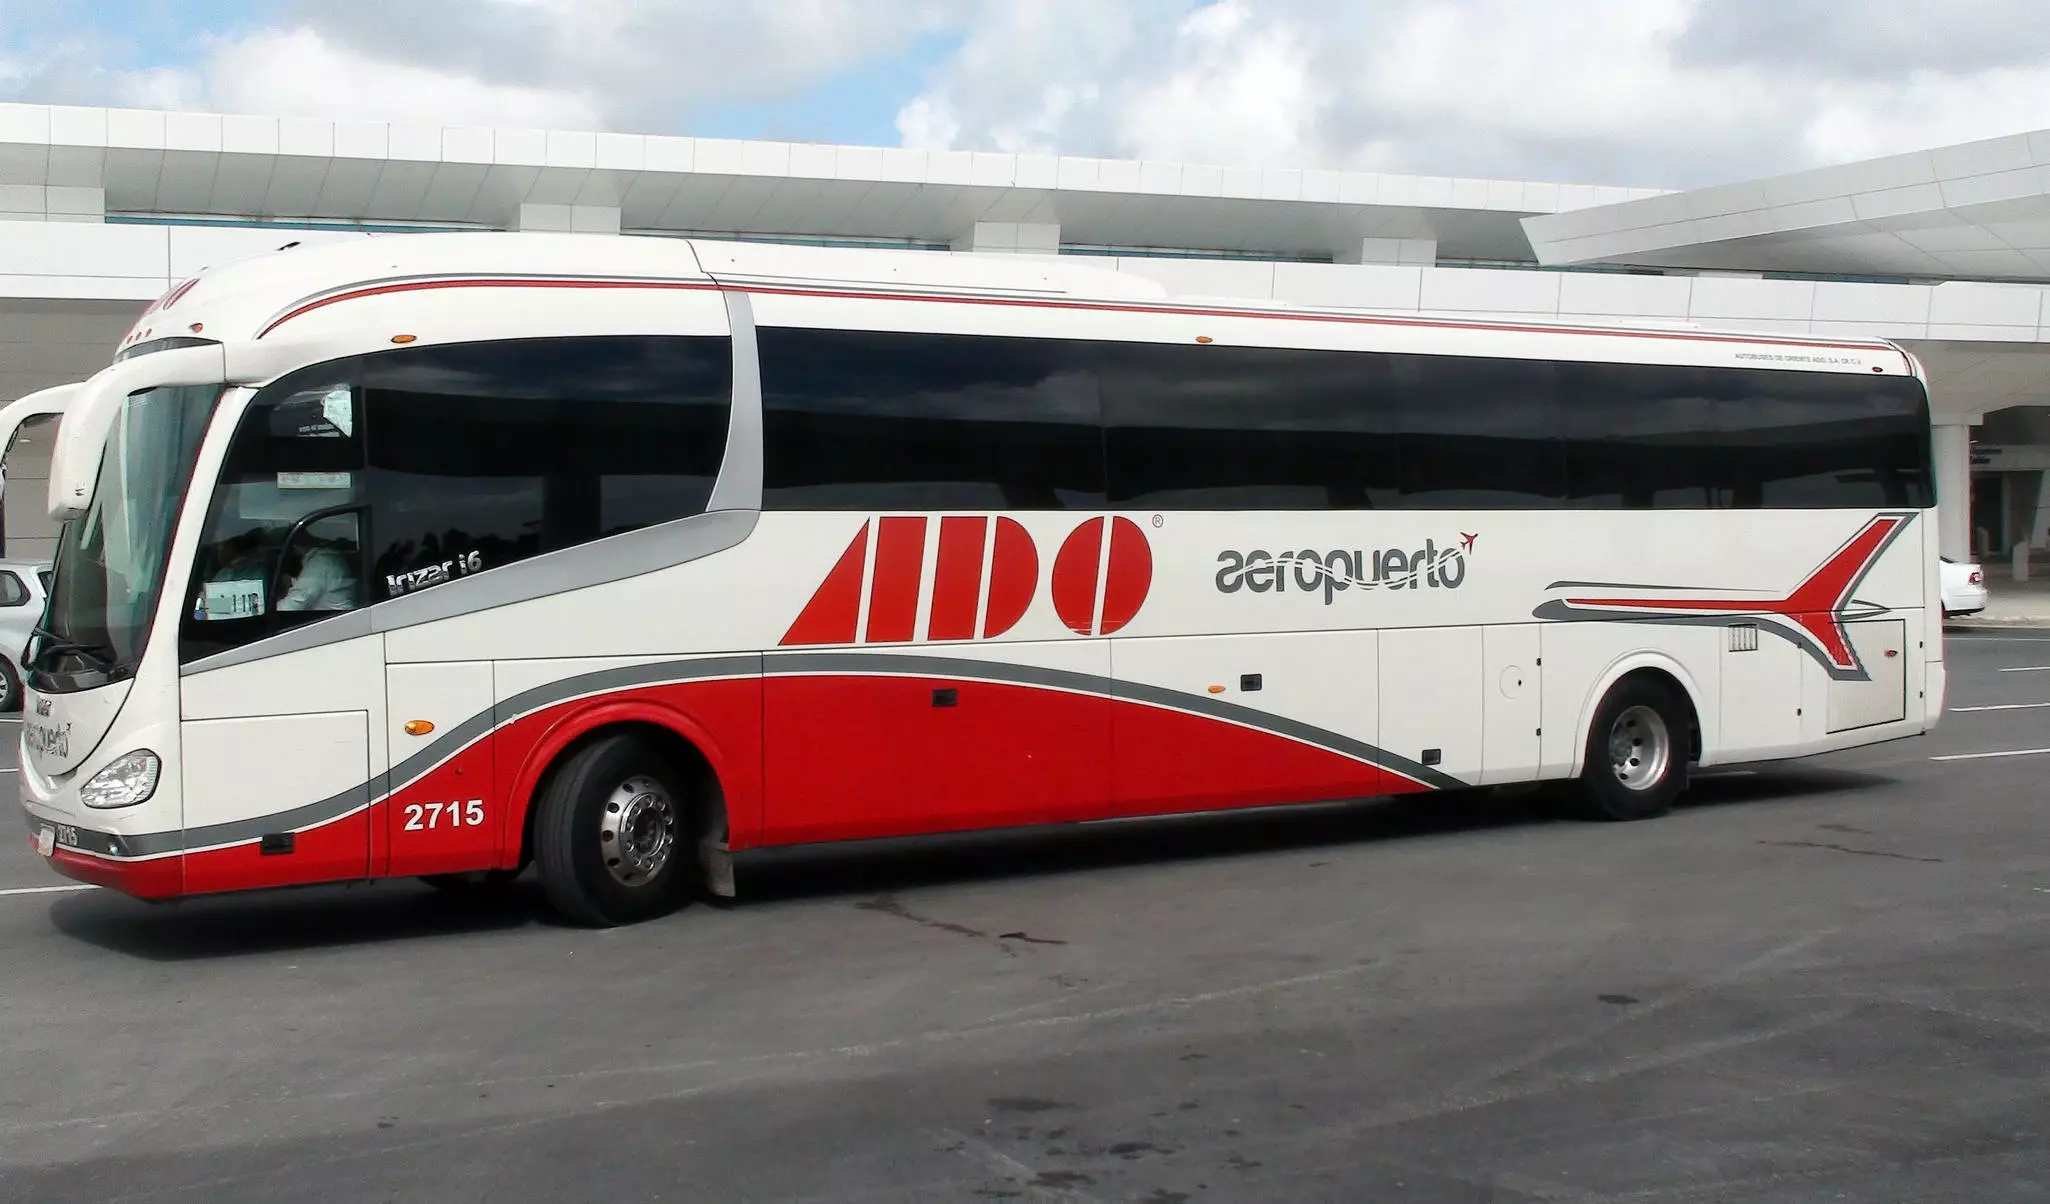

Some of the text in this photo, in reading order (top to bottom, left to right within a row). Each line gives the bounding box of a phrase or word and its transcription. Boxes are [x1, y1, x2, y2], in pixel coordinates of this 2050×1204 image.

[386, 550, 482, 597] Irizar i6
[778, 515, 1153, 646] ADO
[1215, 538, 1466, 605] aeropuerto
[404, 799, 484, 831] 2715
